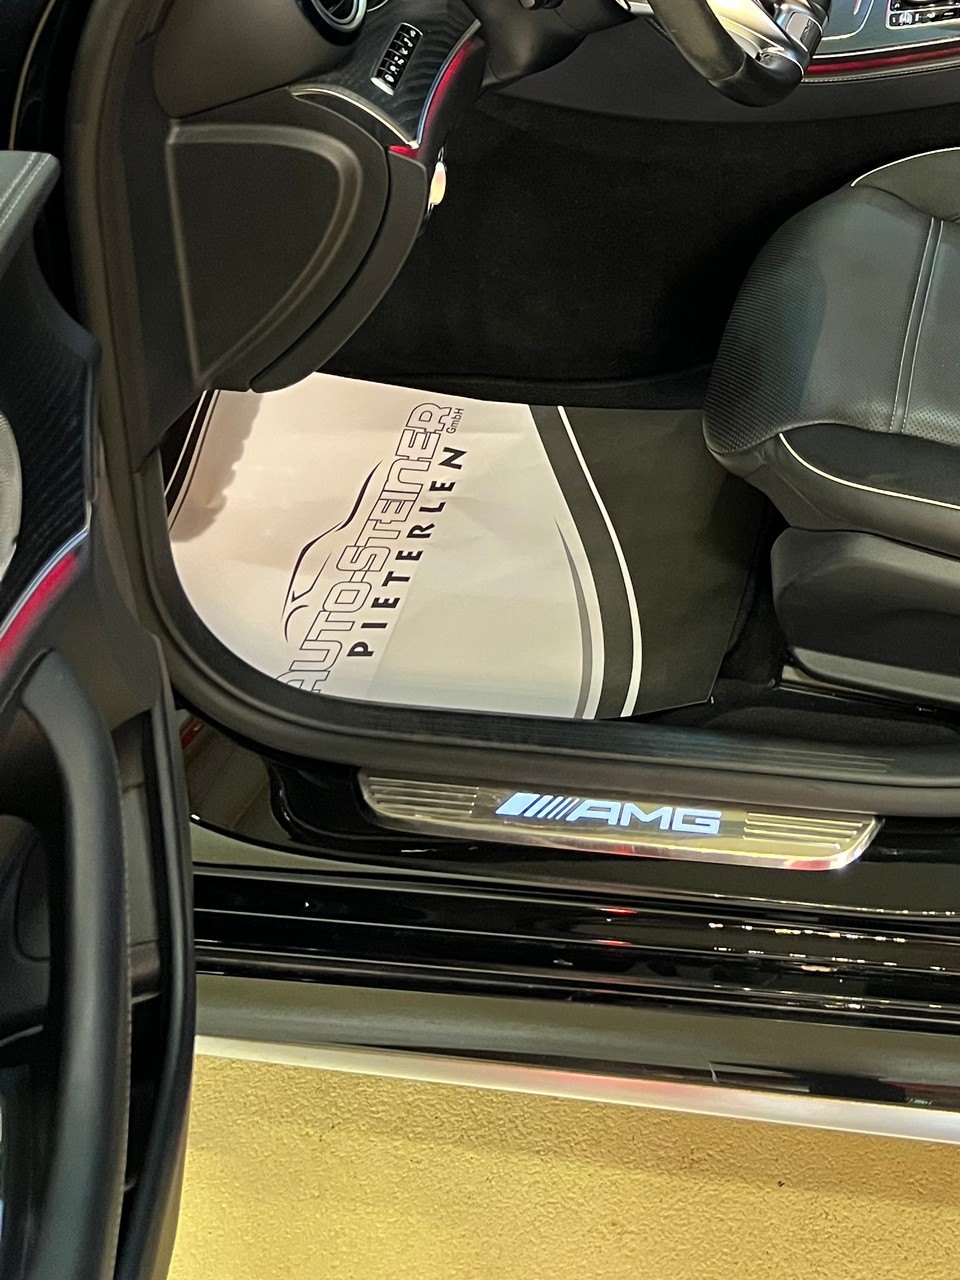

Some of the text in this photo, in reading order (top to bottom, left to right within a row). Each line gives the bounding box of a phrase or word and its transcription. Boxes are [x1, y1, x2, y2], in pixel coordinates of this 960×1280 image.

[445, 407, 465, 434] GmbH
[345, 446, 468, 657] PIETERLEN
[566, 799, 723, 835] AMG
